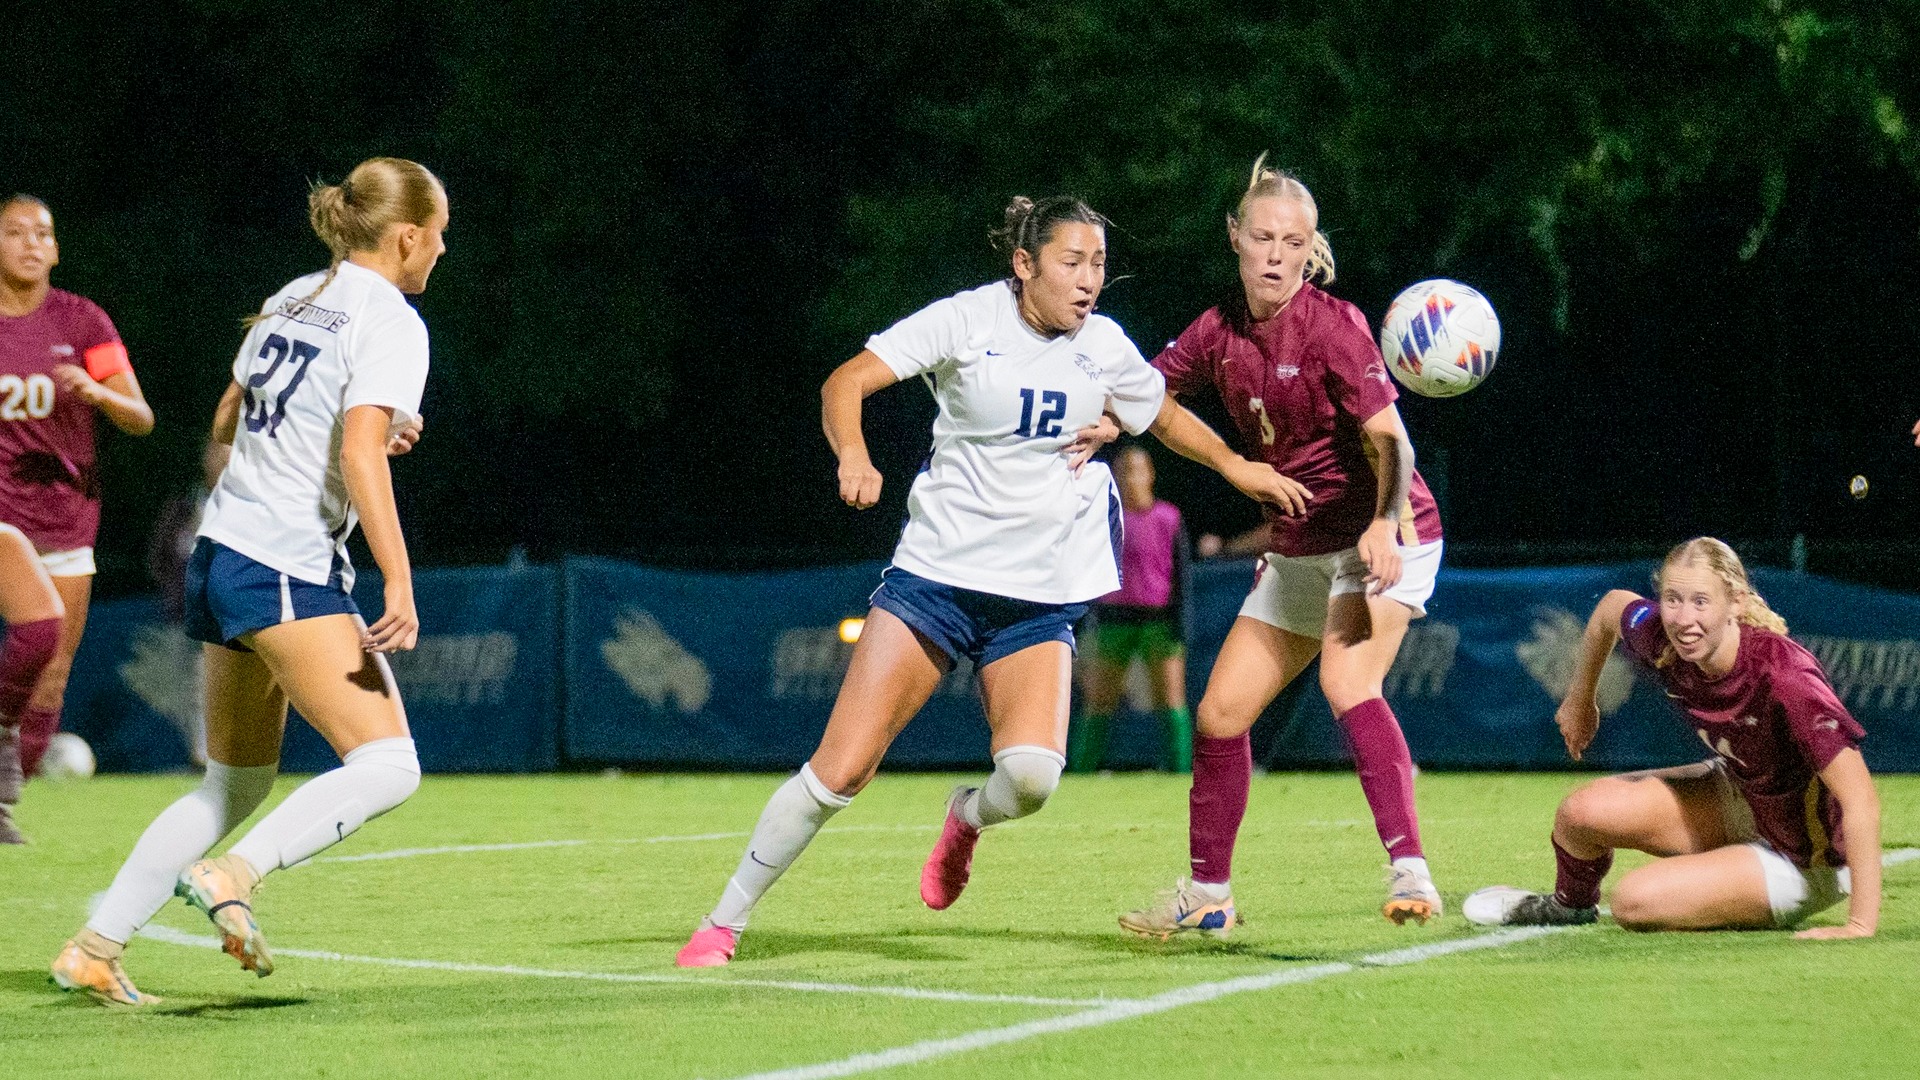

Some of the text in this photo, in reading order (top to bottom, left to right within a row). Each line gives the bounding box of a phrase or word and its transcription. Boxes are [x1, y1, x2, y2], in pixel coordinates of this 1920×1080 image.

[0, 374, 55, 420] 20
[244, 333, 322, 438] 27
[1013, 388, 1067, 438] 12
